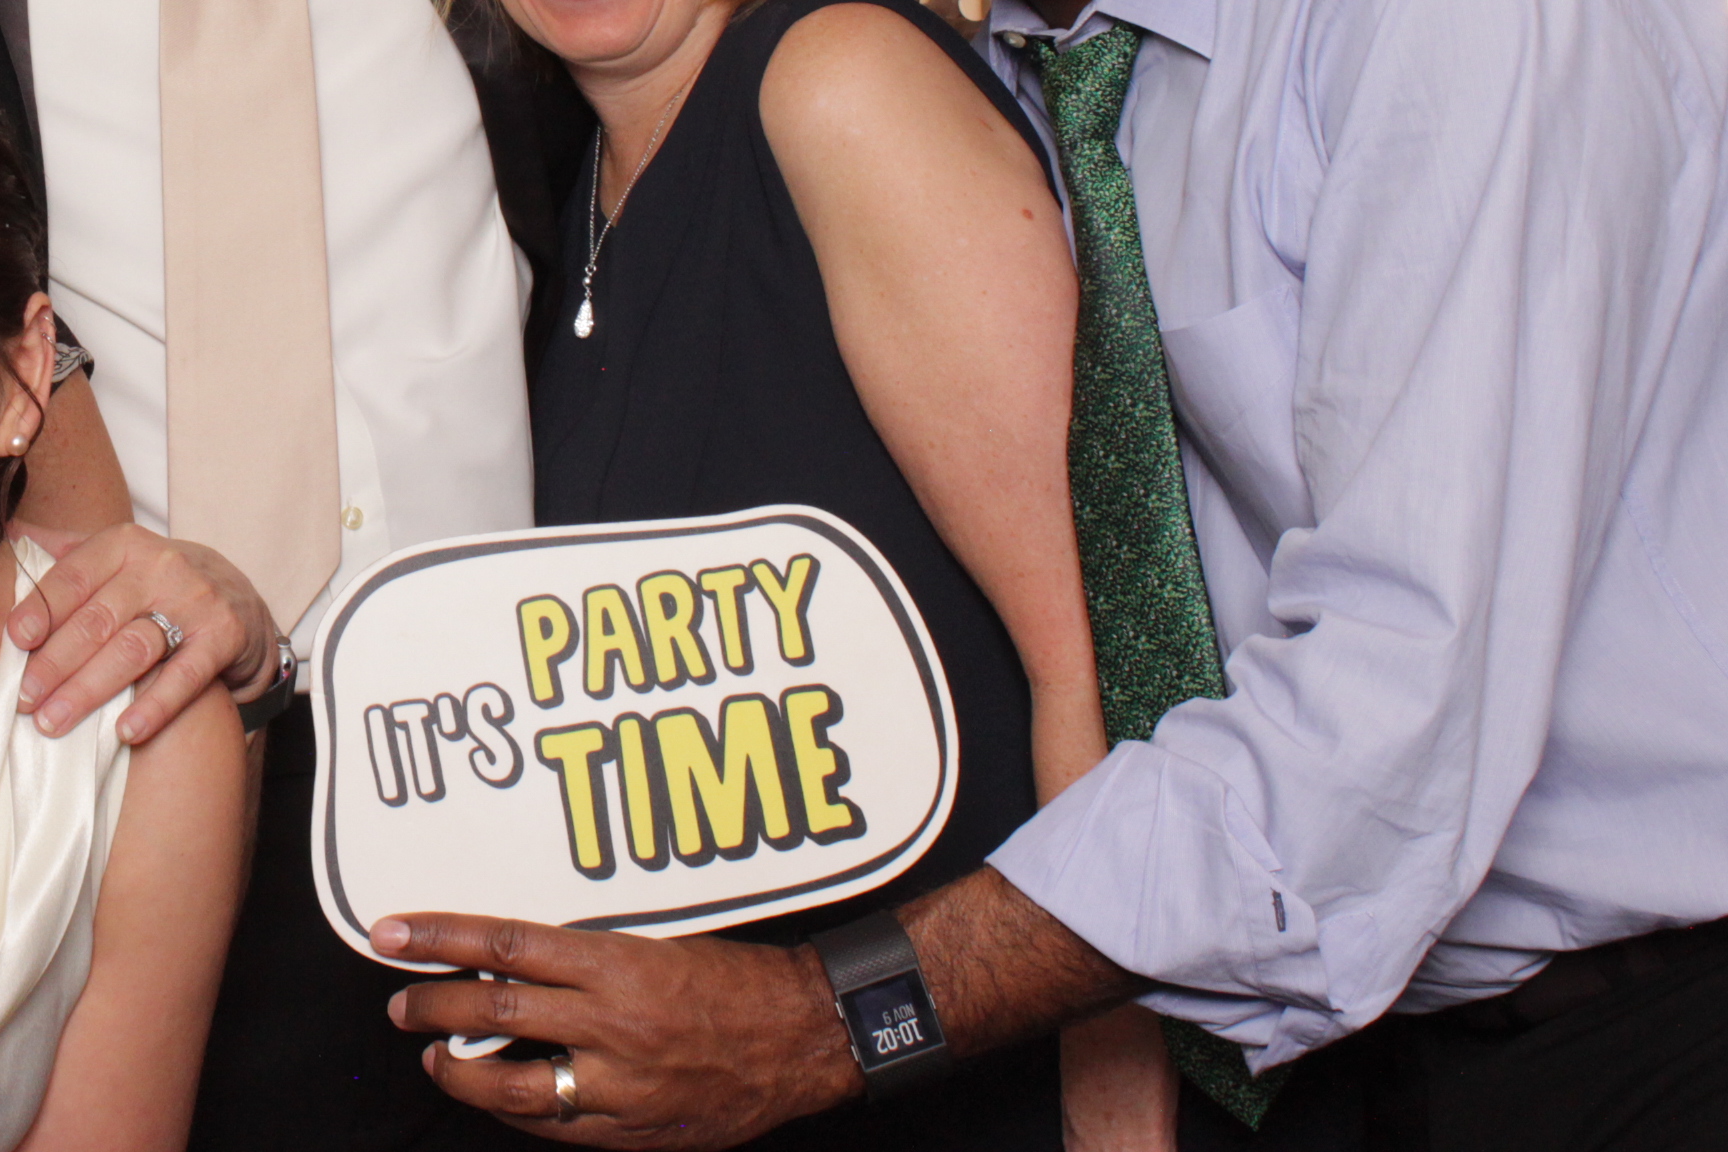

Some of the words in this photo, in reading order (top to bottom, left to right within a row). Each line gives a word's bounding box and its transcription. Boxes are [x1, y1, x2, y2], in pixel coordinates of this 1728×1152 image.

[516, 553, 821, 709] PARTY
[364, 682, 524, 807] IT'S
[534, 684, 867, 881] TIME
[872, 1018, 924, 1055] 10:02
[882, 1011, 892, 1026] 9
[893, 1003, 916, 1022] NOV
